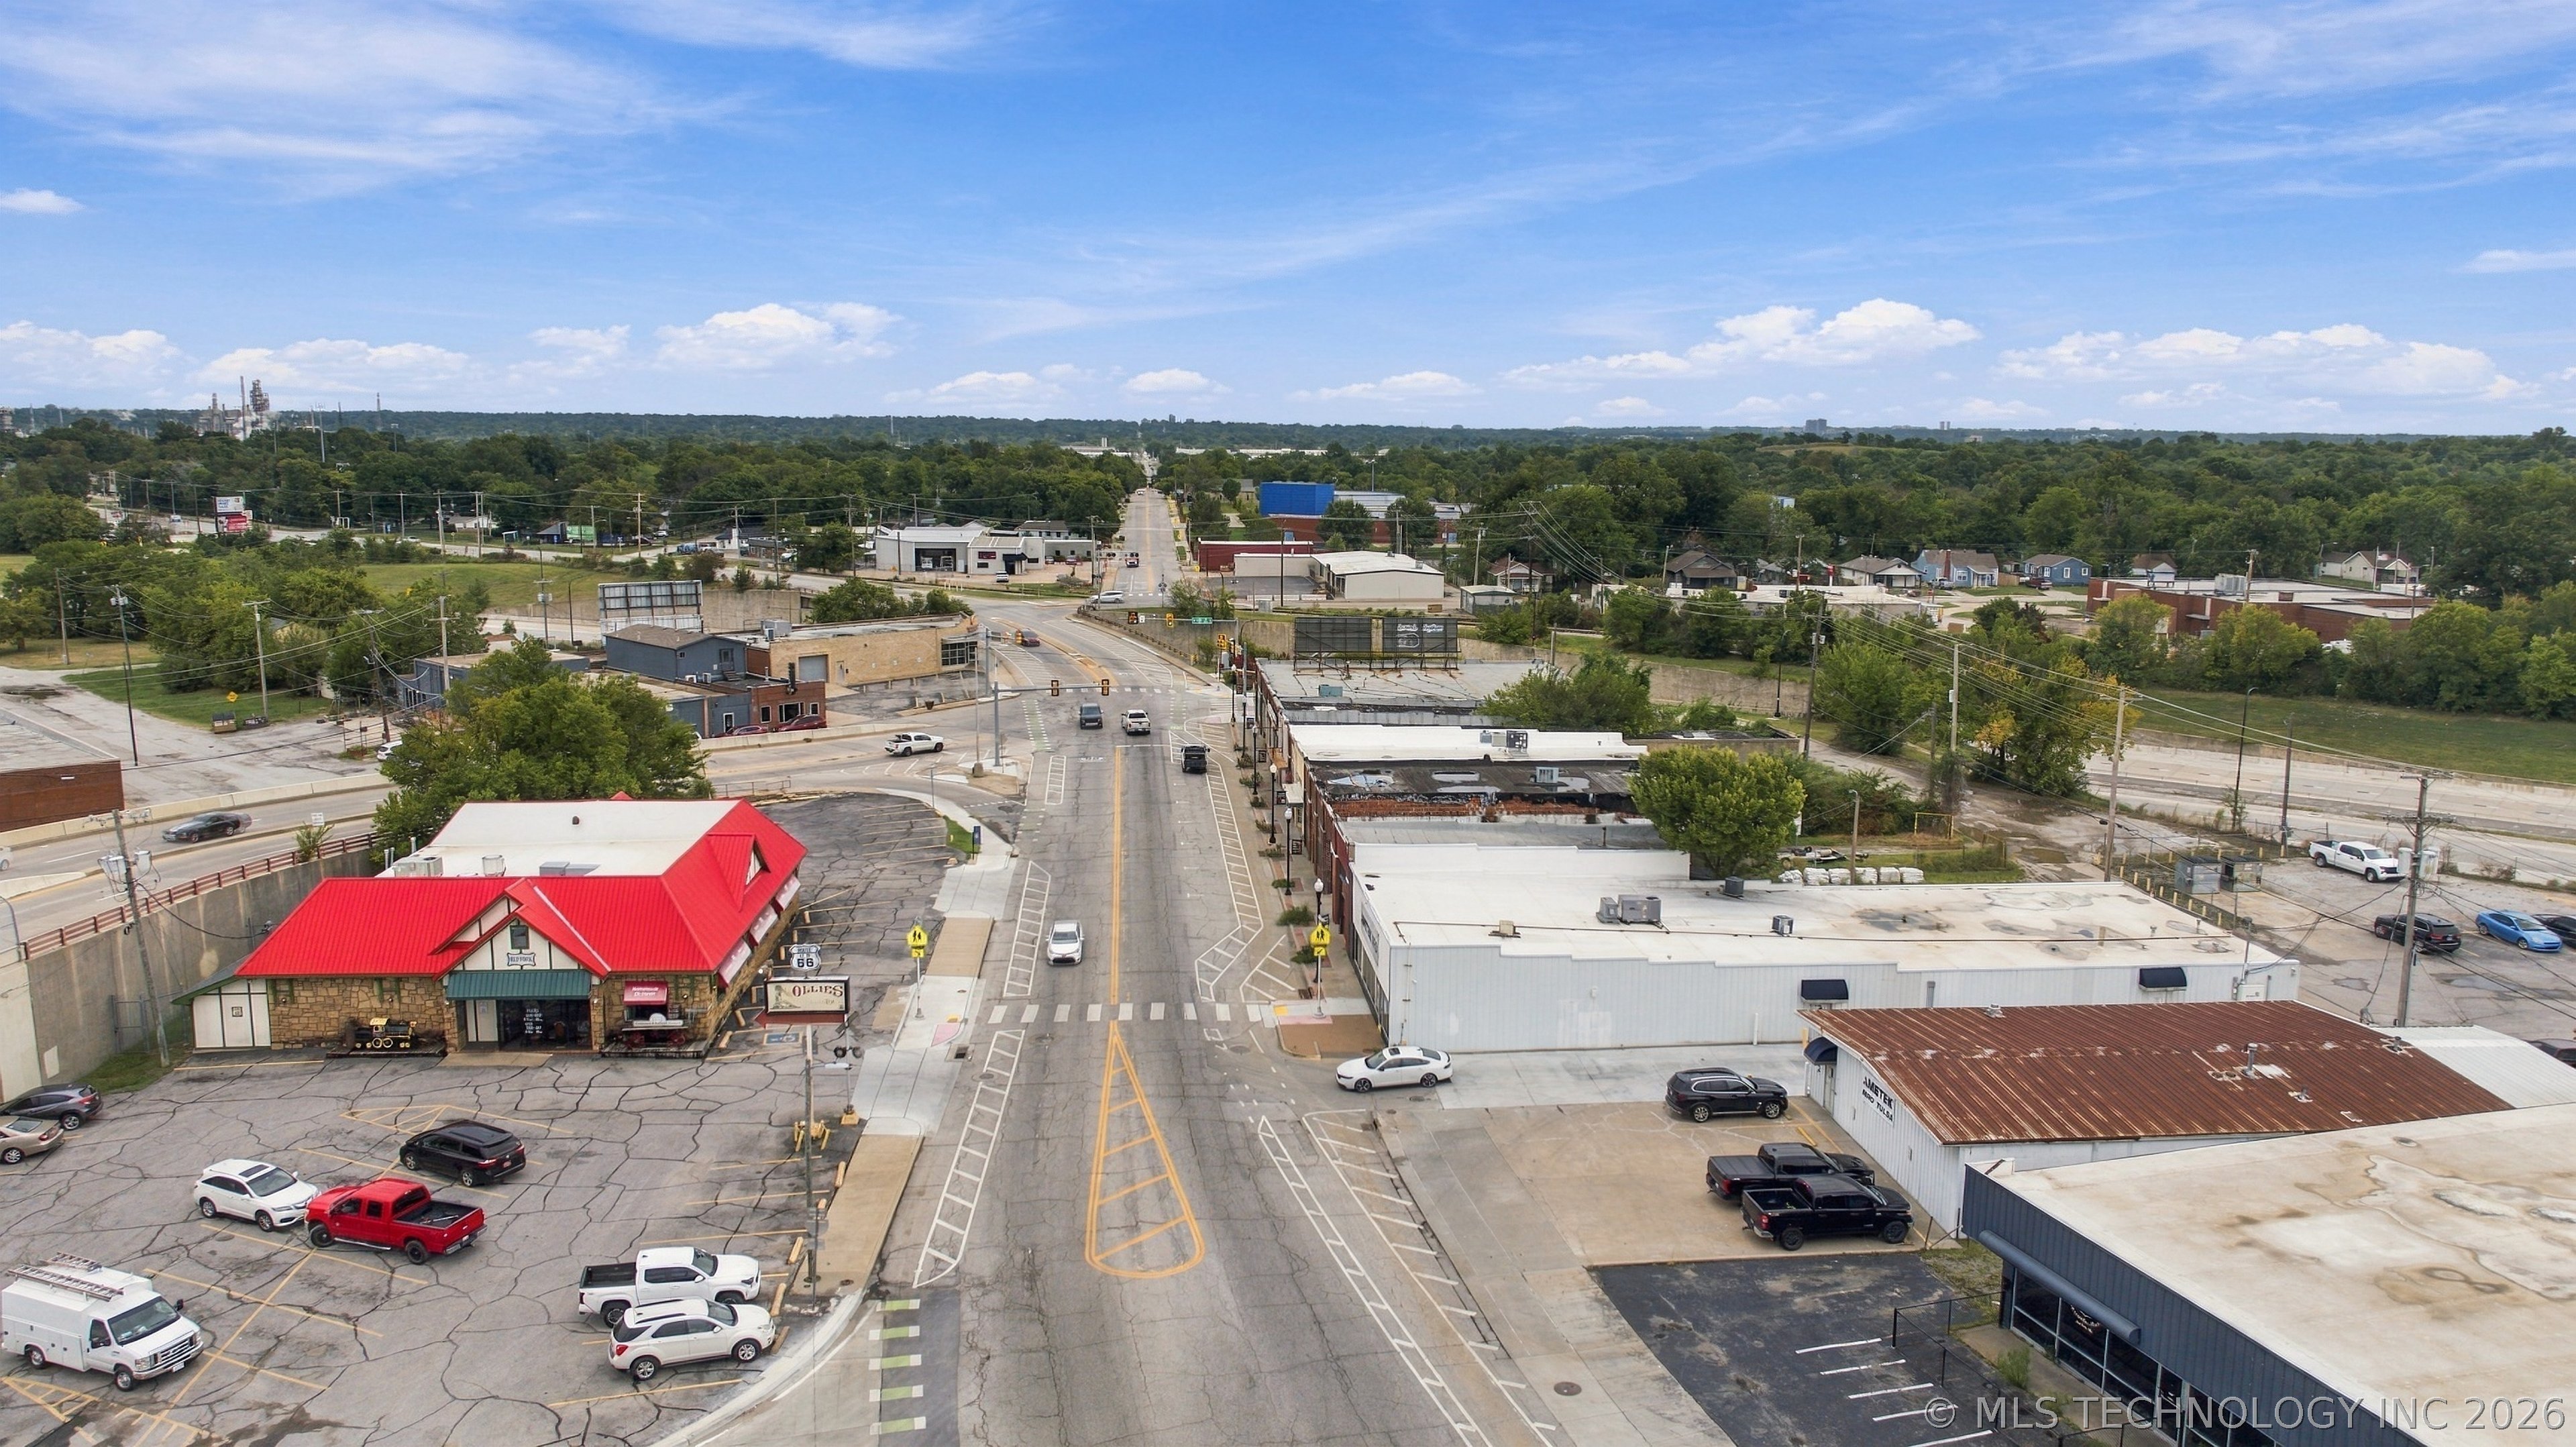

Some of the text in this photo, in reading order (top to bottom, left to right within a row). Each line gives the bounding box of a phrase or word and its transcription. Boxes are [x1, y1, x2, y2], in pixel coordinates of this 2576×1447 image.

[797, 958, 814, 968] 66
[792, 985, 843, 997] OLLIES
[1863, 1075, 1893, 1110] AMETEK
[1862, 1089, 1893, 1122] MRO TULSA
